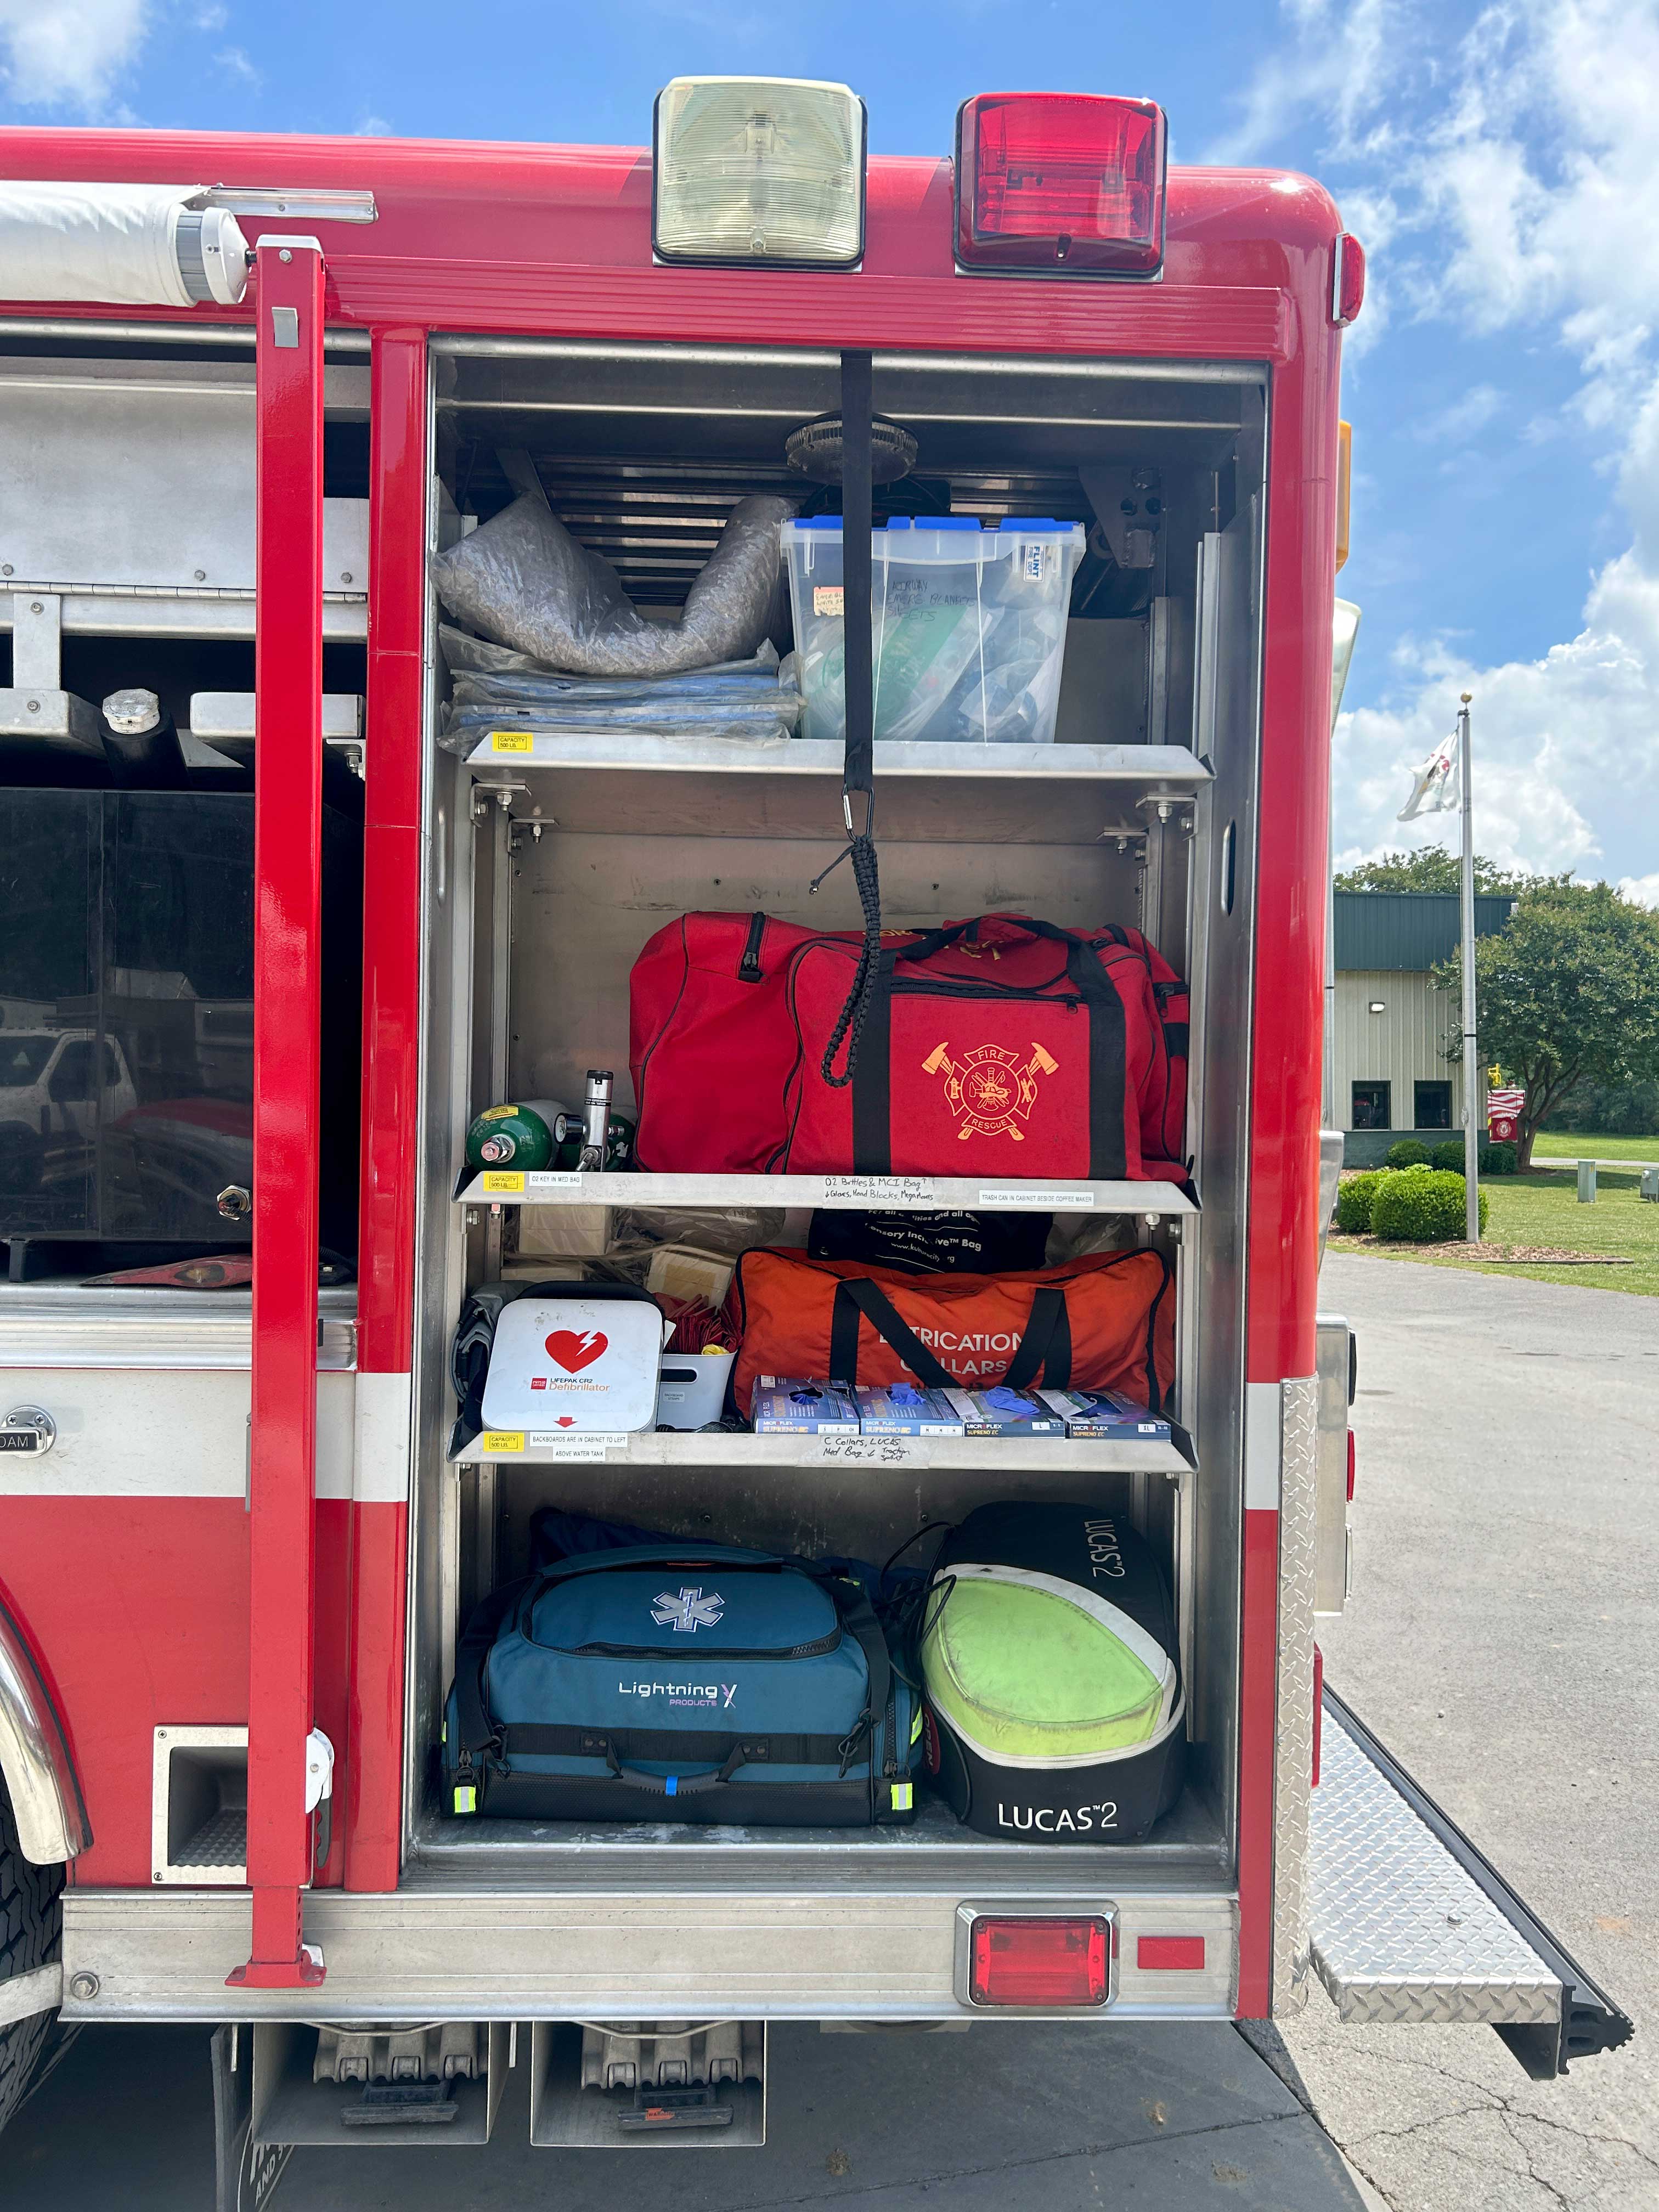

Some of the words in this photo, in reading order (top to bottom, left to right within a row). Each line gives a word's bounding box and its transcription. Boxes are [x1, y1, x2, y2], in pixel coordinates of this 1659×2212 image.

[1032, 546, 1040, 578] FLINT
[892, 578, 928, 592] AIRWAY
[930, 593, 976, 606] BLANKETS
[887, 604, 937, 622] SHEETS
[978, 1049, 1006, 1061] FIRE
[971, 1118, 1008, 1130] RESCUE
[841, 1178, 867, 1187] Bottles
[869, 1177, 876, 1187] &
[878, 1177, 900, 1186] MCI
[904, 1178, 921, 1192] Bag
[853, 1188, 868, 1197] Head
[870, 1189, 900, 1201] Blocks,
[934, 1210, 949, 1221] and
[865, 1222, 905, 1239] ensory
[961, 1239, 982, 1252] Bag
[879, 1325, 1023, 1352] TRICATION
[549, 1383, 610, 1391] Defibrillator
[0, 1436, 28, 1448] OAM
[825, 1437, 832, 1445] C
[836, 1438, 867, 1447] Collars,
[823, 1447, 841, 1457] Med
[619, 1681, 718, 1699] Lightning
[924, 1713, 933, 1767] OPEN
[255, 2154, 276, 2207] AND
